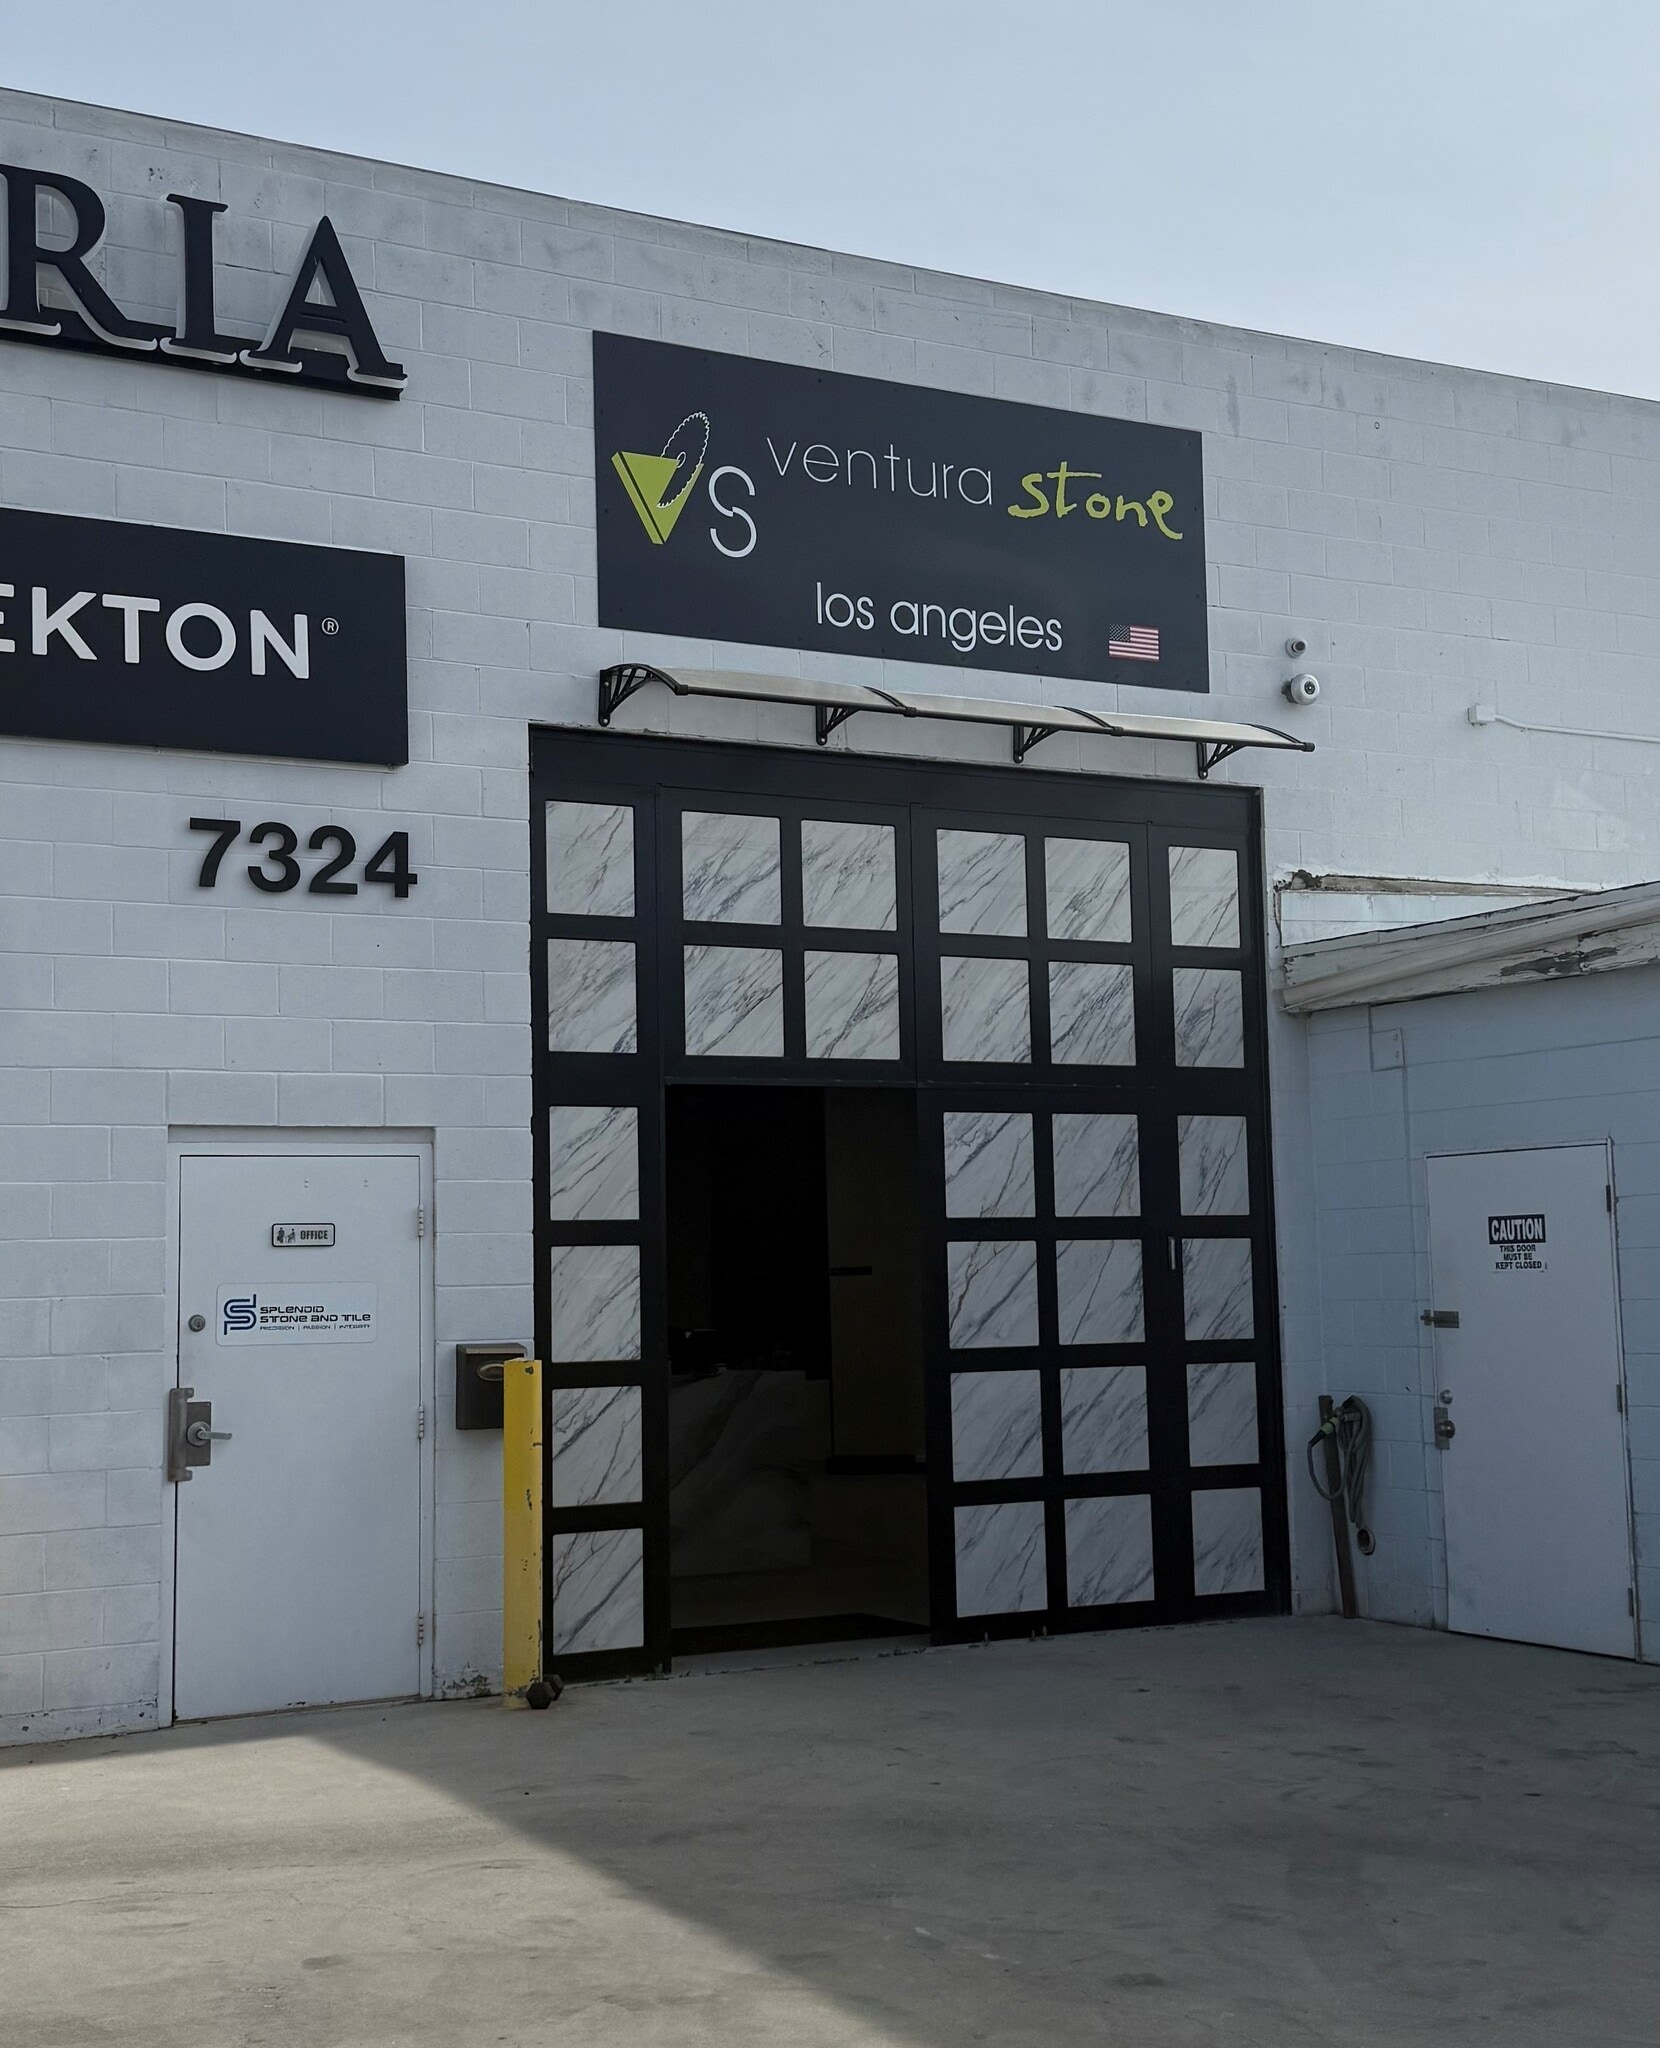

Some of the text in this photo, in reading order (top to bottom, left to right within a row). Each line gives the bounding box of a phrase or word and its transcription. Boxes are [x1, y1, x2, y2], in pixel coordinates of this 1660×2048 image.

[766, 436, 1184, 540] ventura stone
[815, 581, 1063, 653] los angeles
[189, 817, 418, 899] 7324
[300, 1229, 329, 1240] OFFICE
[1491, 1217, 1544, 1242] CAUTION
[1499, 1244, 1536, 1253] THIS DOOR
[1503, 1253, 1522, 1261] MUST
[1495, 1261, 1542, 1270] KEPT CLOSED
[260, 1305, 325, 1314] SPLENDID
[260, 1313, 371, 1323] STONE AND TILE
